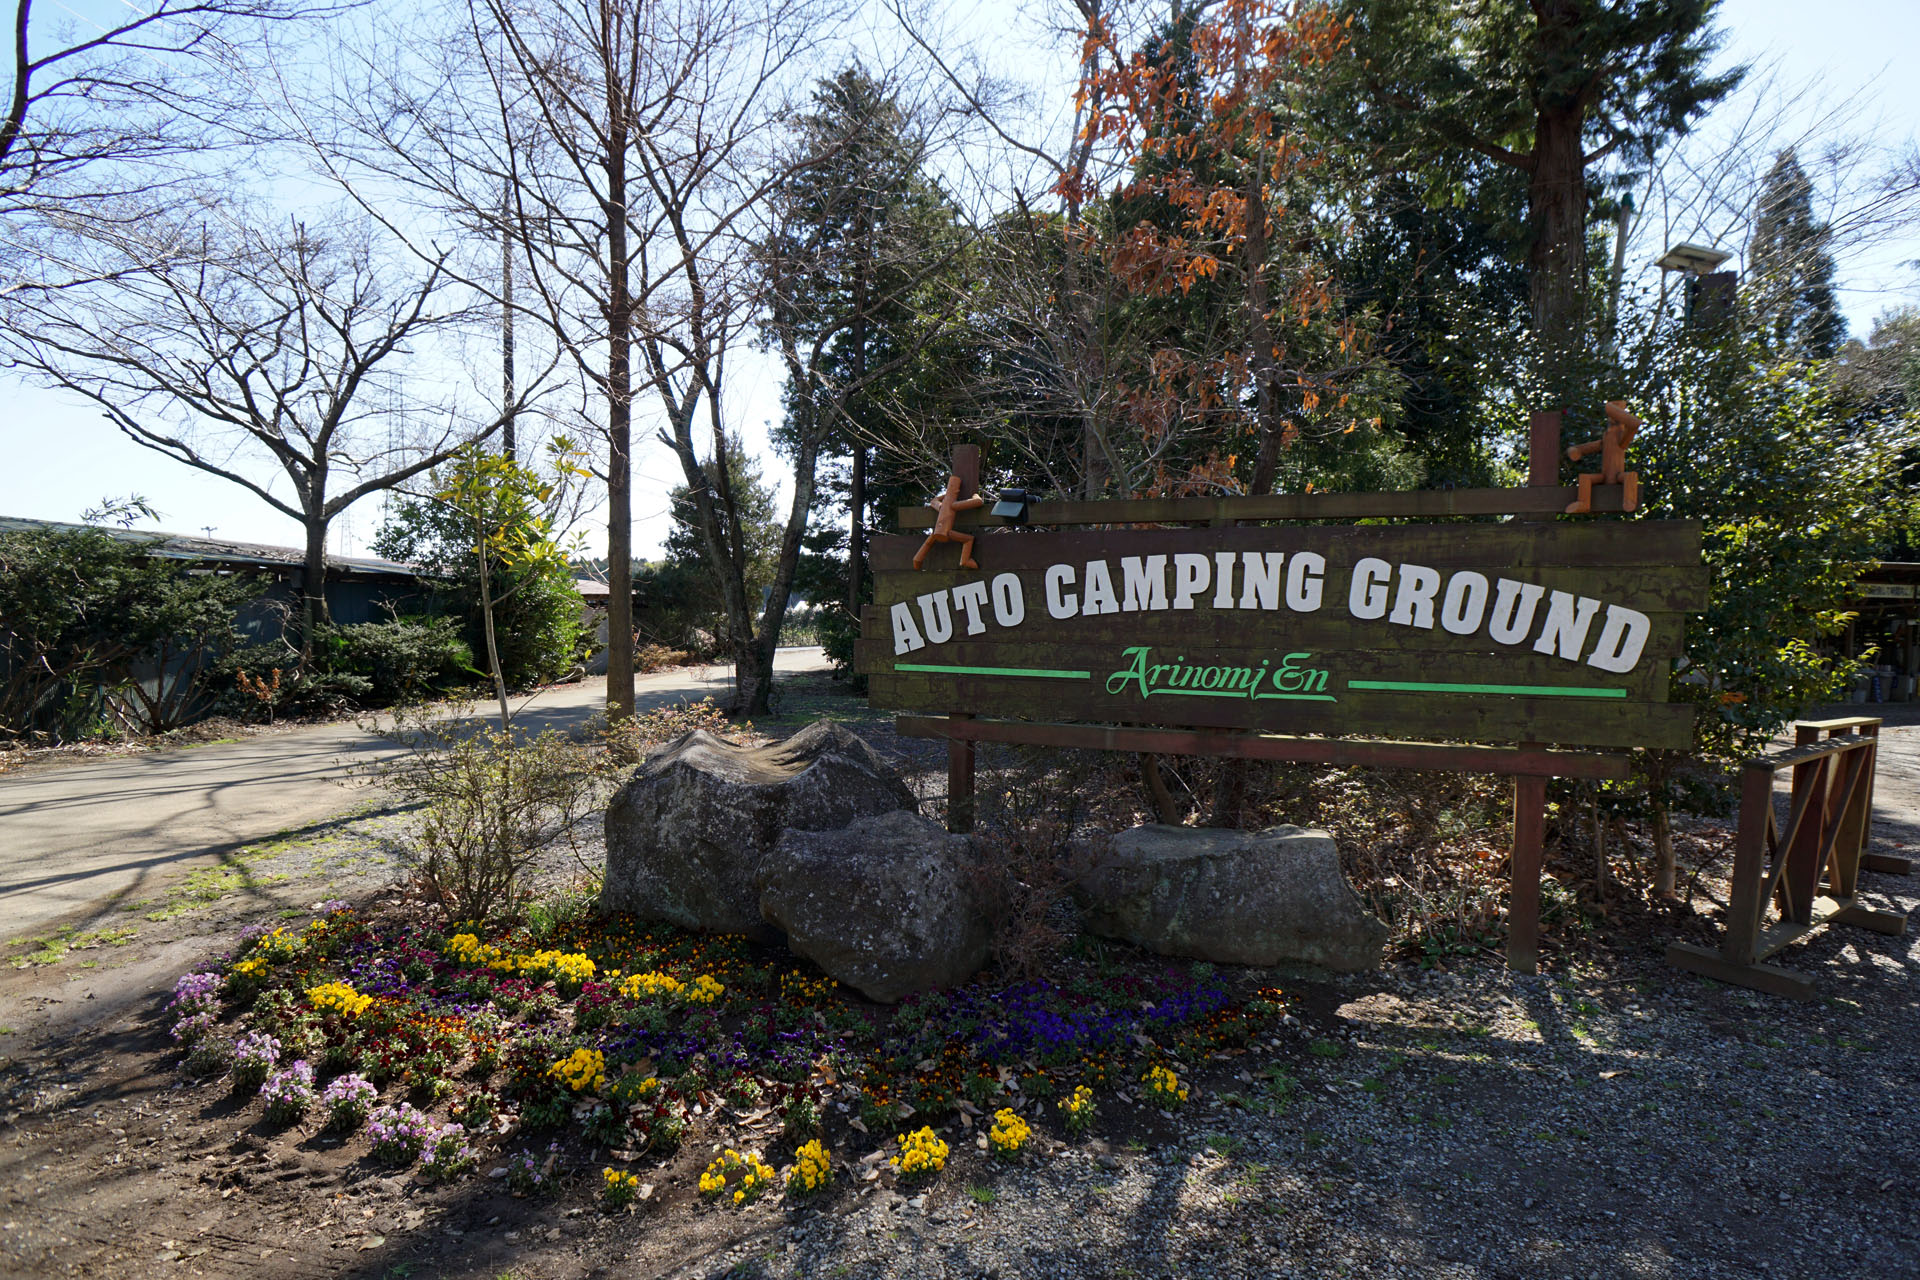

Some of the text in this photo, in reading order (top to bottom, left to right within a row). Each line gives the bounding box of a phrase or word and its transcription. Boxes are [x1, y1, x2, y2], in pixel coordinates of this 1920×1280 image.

[890, 553, 1651, 673] AUTO CAMPING GROUND
[1105, 646, 1330, 700] Arinomi En
